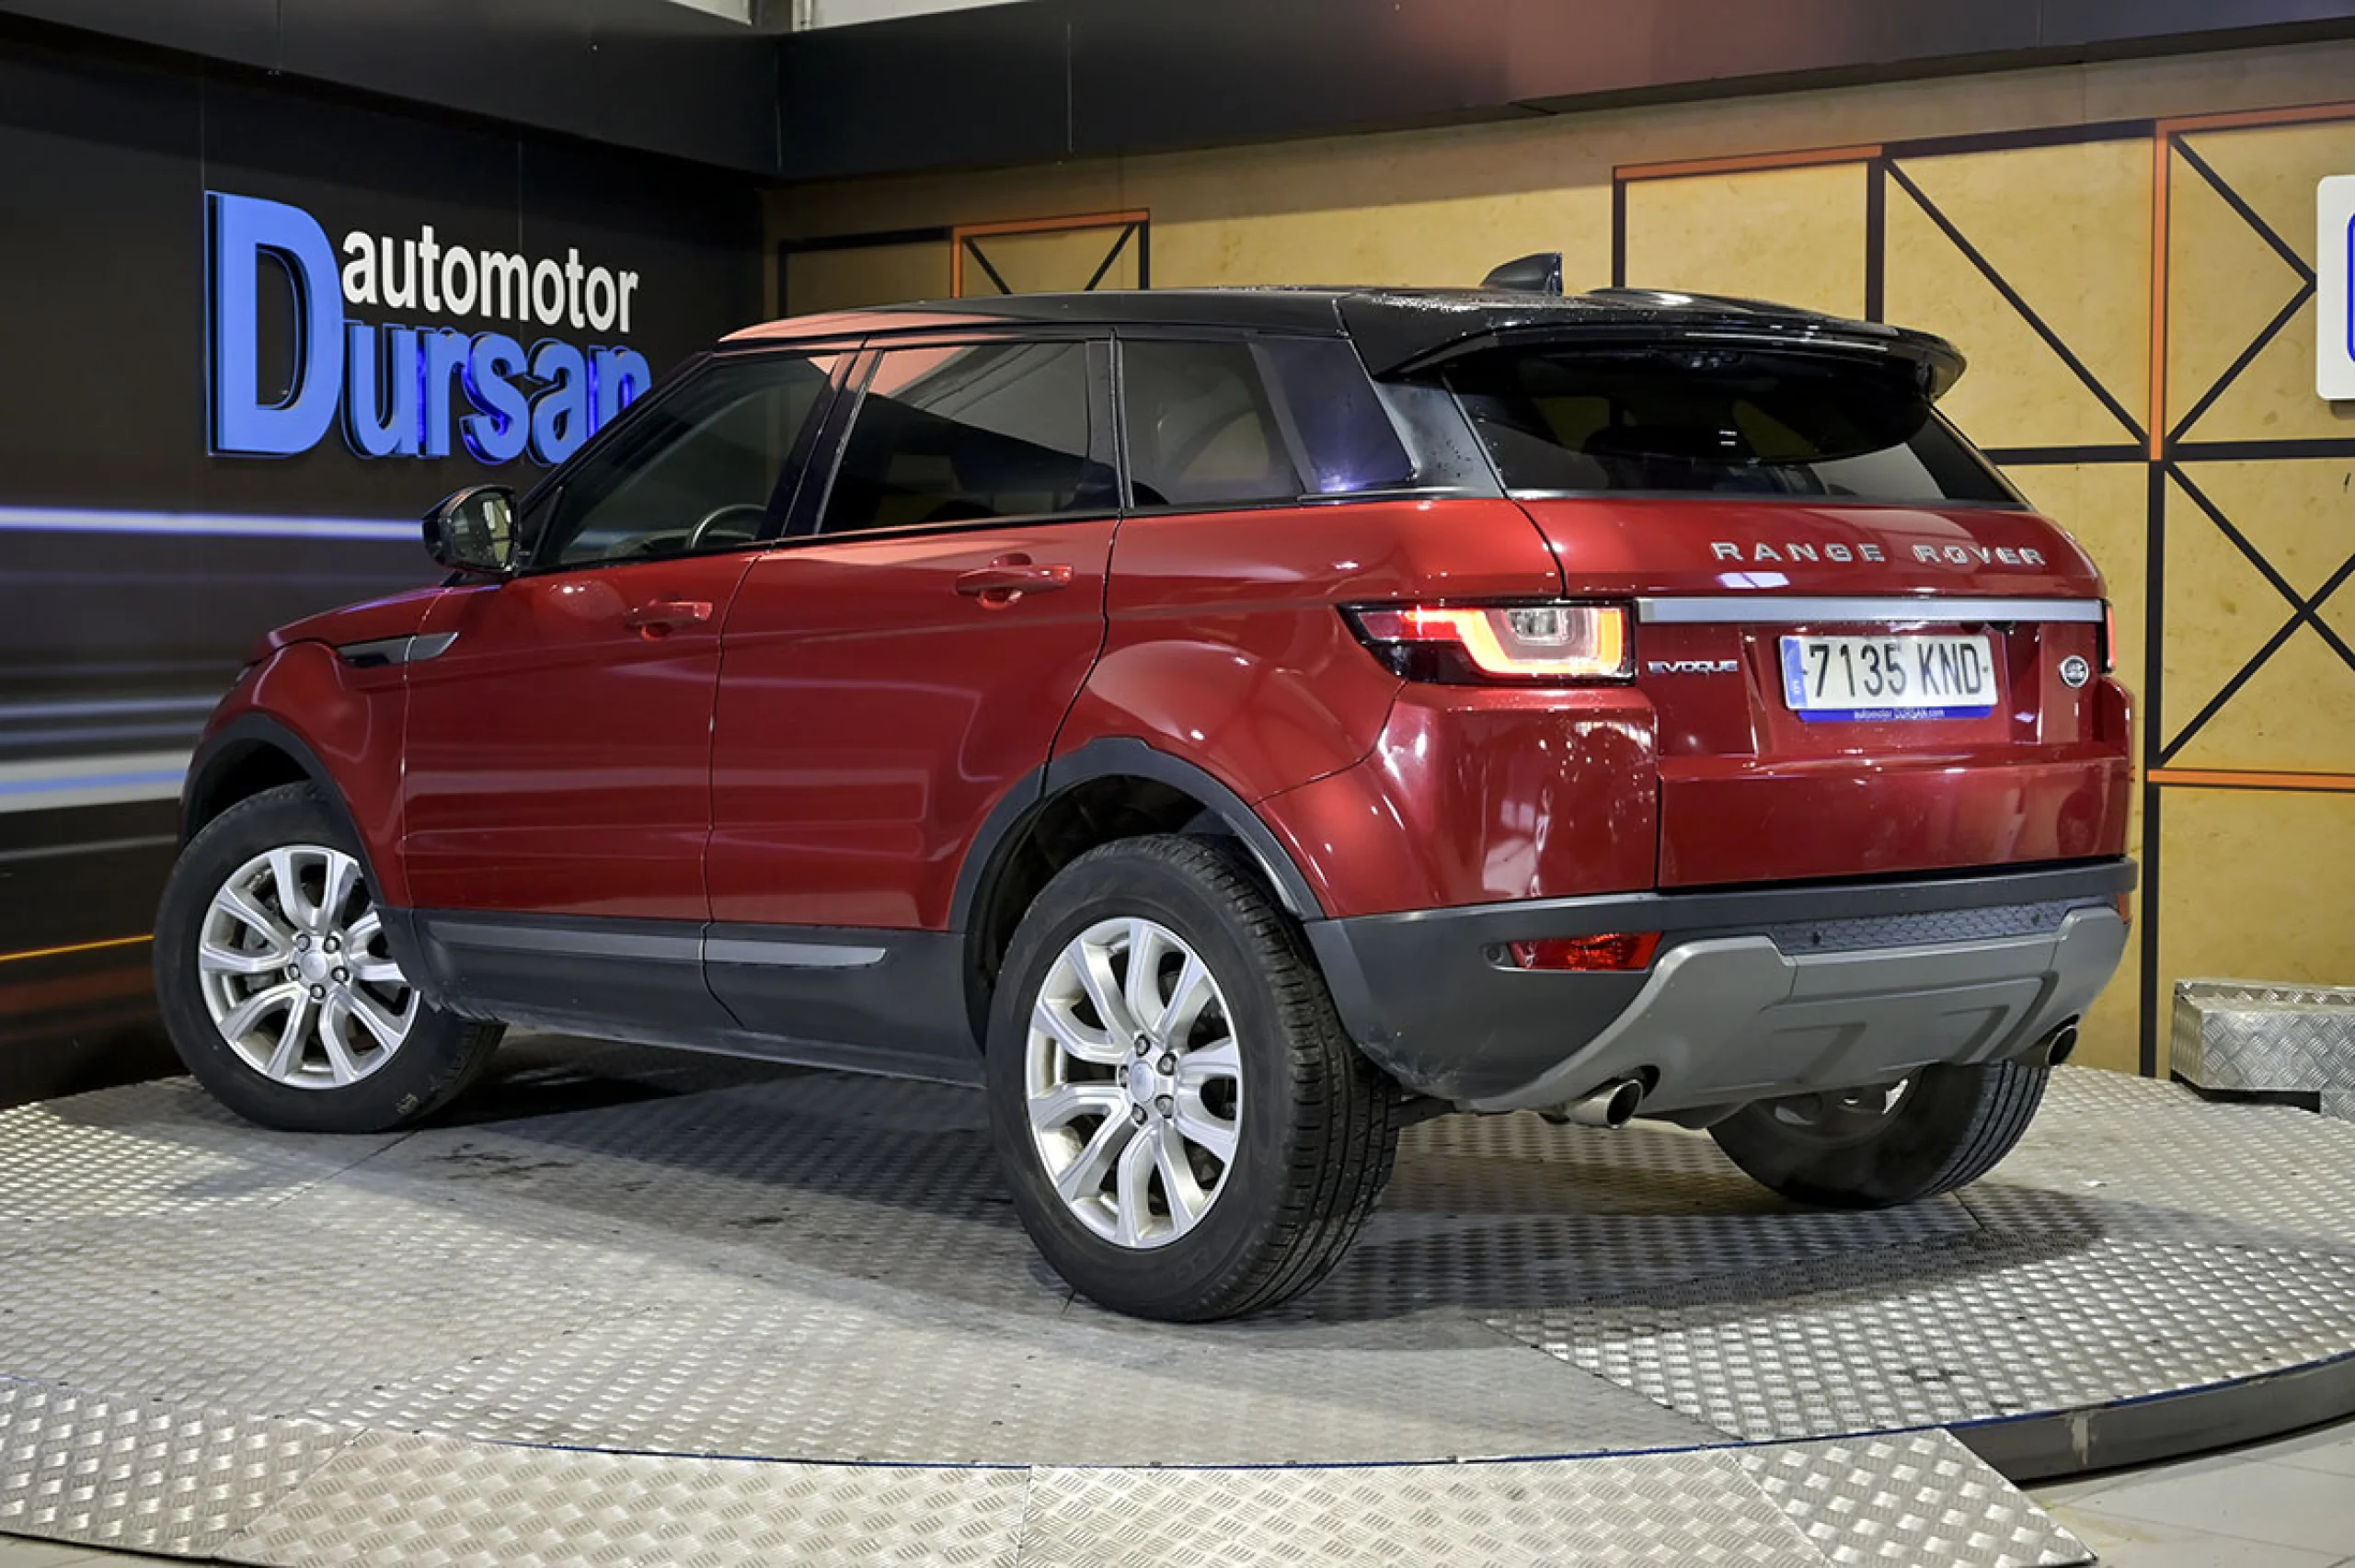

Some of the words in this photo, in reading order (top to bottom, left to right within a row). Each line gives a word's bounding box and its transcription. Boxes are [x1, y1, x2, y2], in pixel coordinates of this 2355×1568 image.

[342, 225, 638, 332] automotor
[1710, 543, 1885, 562] RANGE
[1912, 544, 2046, 566] ROVER
[1648, 659, 1738, 675] EVOQUE
[1809, 643, 1907, 697] 7135
[1917, 642, 1981, 696] KND
